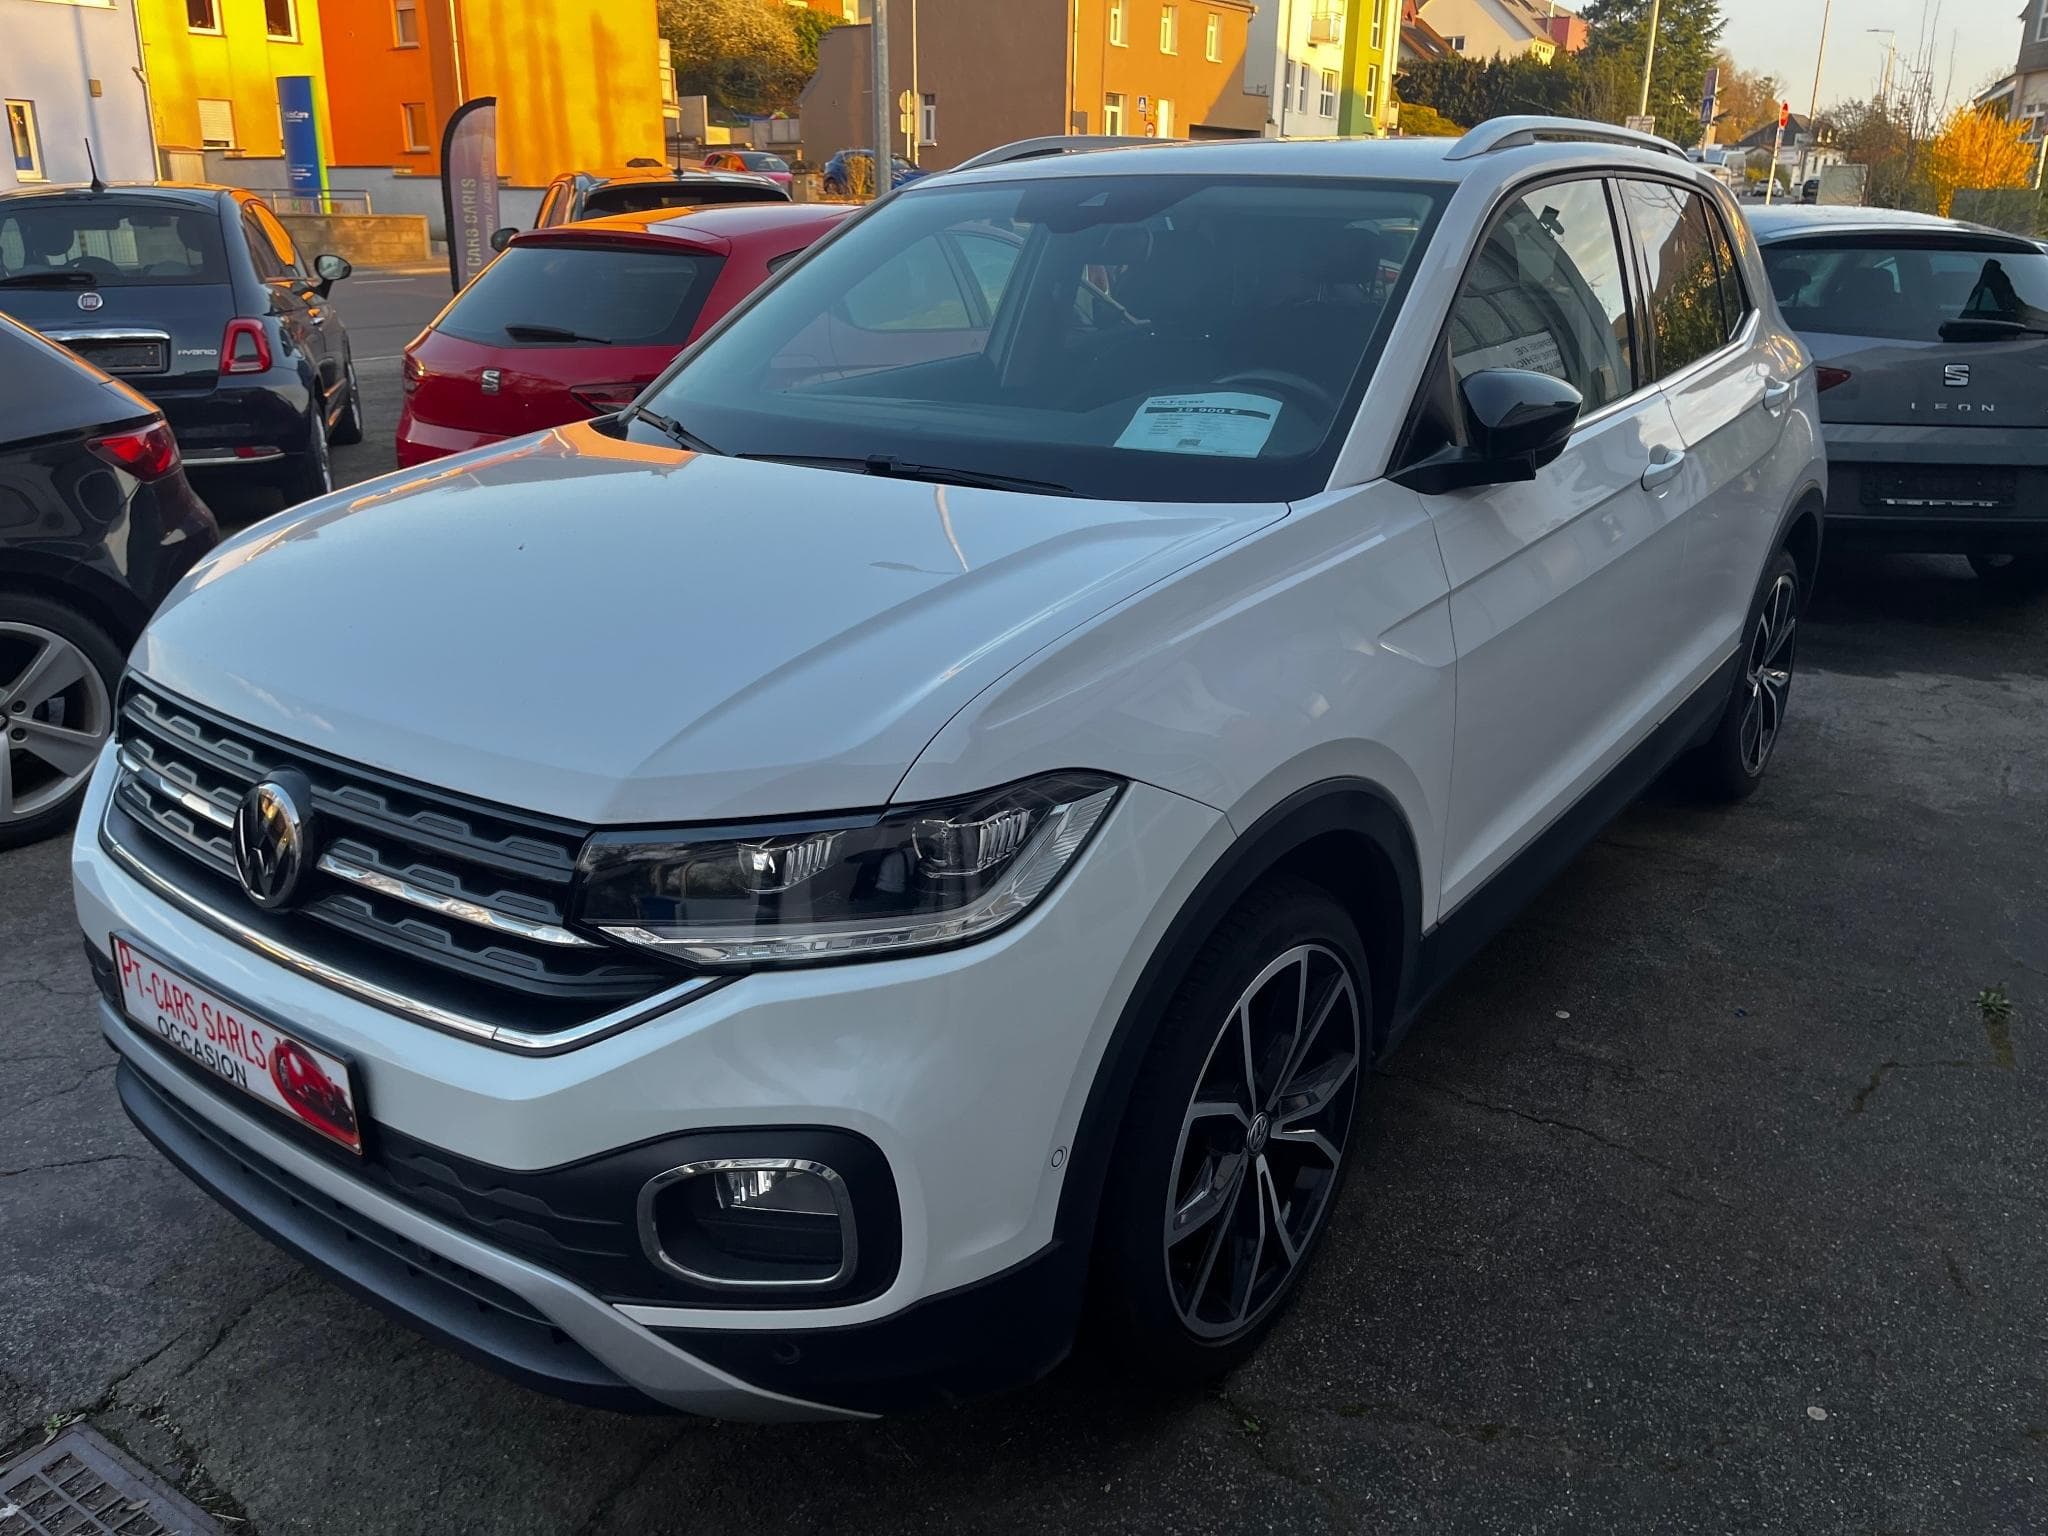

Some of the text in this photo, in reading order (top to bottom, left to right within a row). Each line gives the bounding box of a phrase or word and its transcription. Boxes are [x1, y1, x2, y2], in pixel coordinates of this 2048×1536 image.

[177, 348, 218, 356] HYBRID
[1911, 402, 1995, 412] LEON
[117, 939, 267, 1070] PT-CARS SARLS
[158, 1015, 248, 1089] OCCASION
